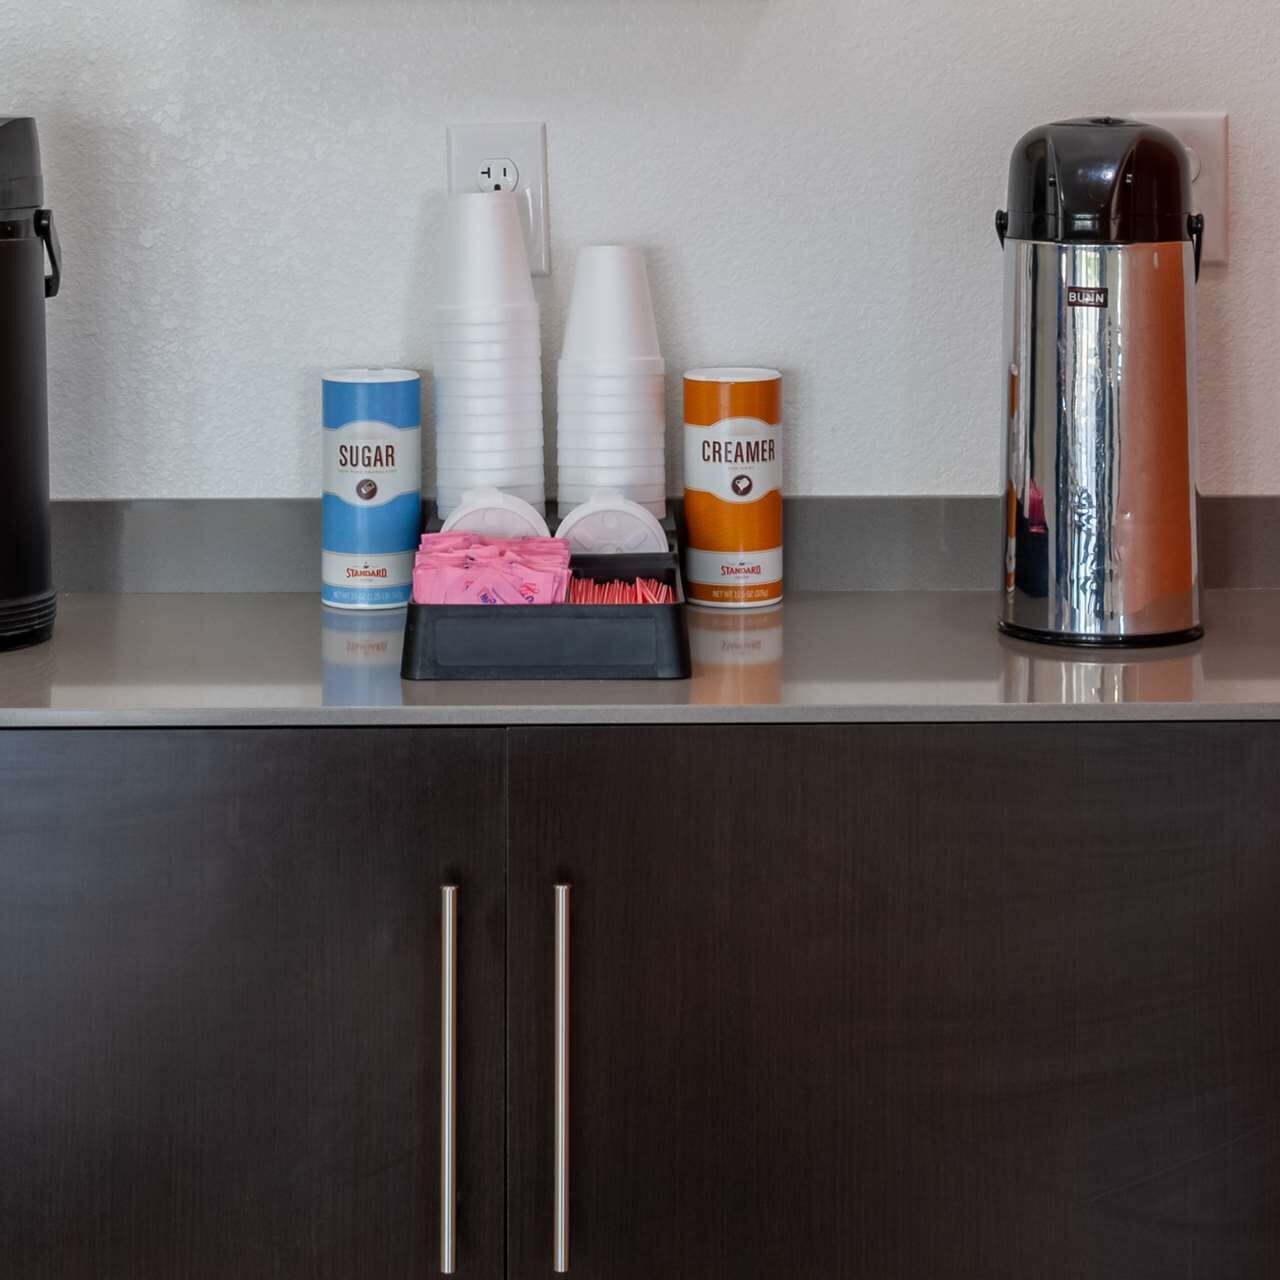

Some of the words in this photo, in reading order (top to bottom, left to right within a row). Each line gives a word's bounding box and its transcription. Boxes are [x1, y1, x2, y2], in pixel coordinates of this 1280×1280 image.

[1068, 291, 1104, 303] BUNN
[339, 444, 395, 468] SUGAR
[702, 439, 776, 463] CREAMER
[345, 567, 388, 578] STANDARD
[720, 565, 762, 577] STANDARD
